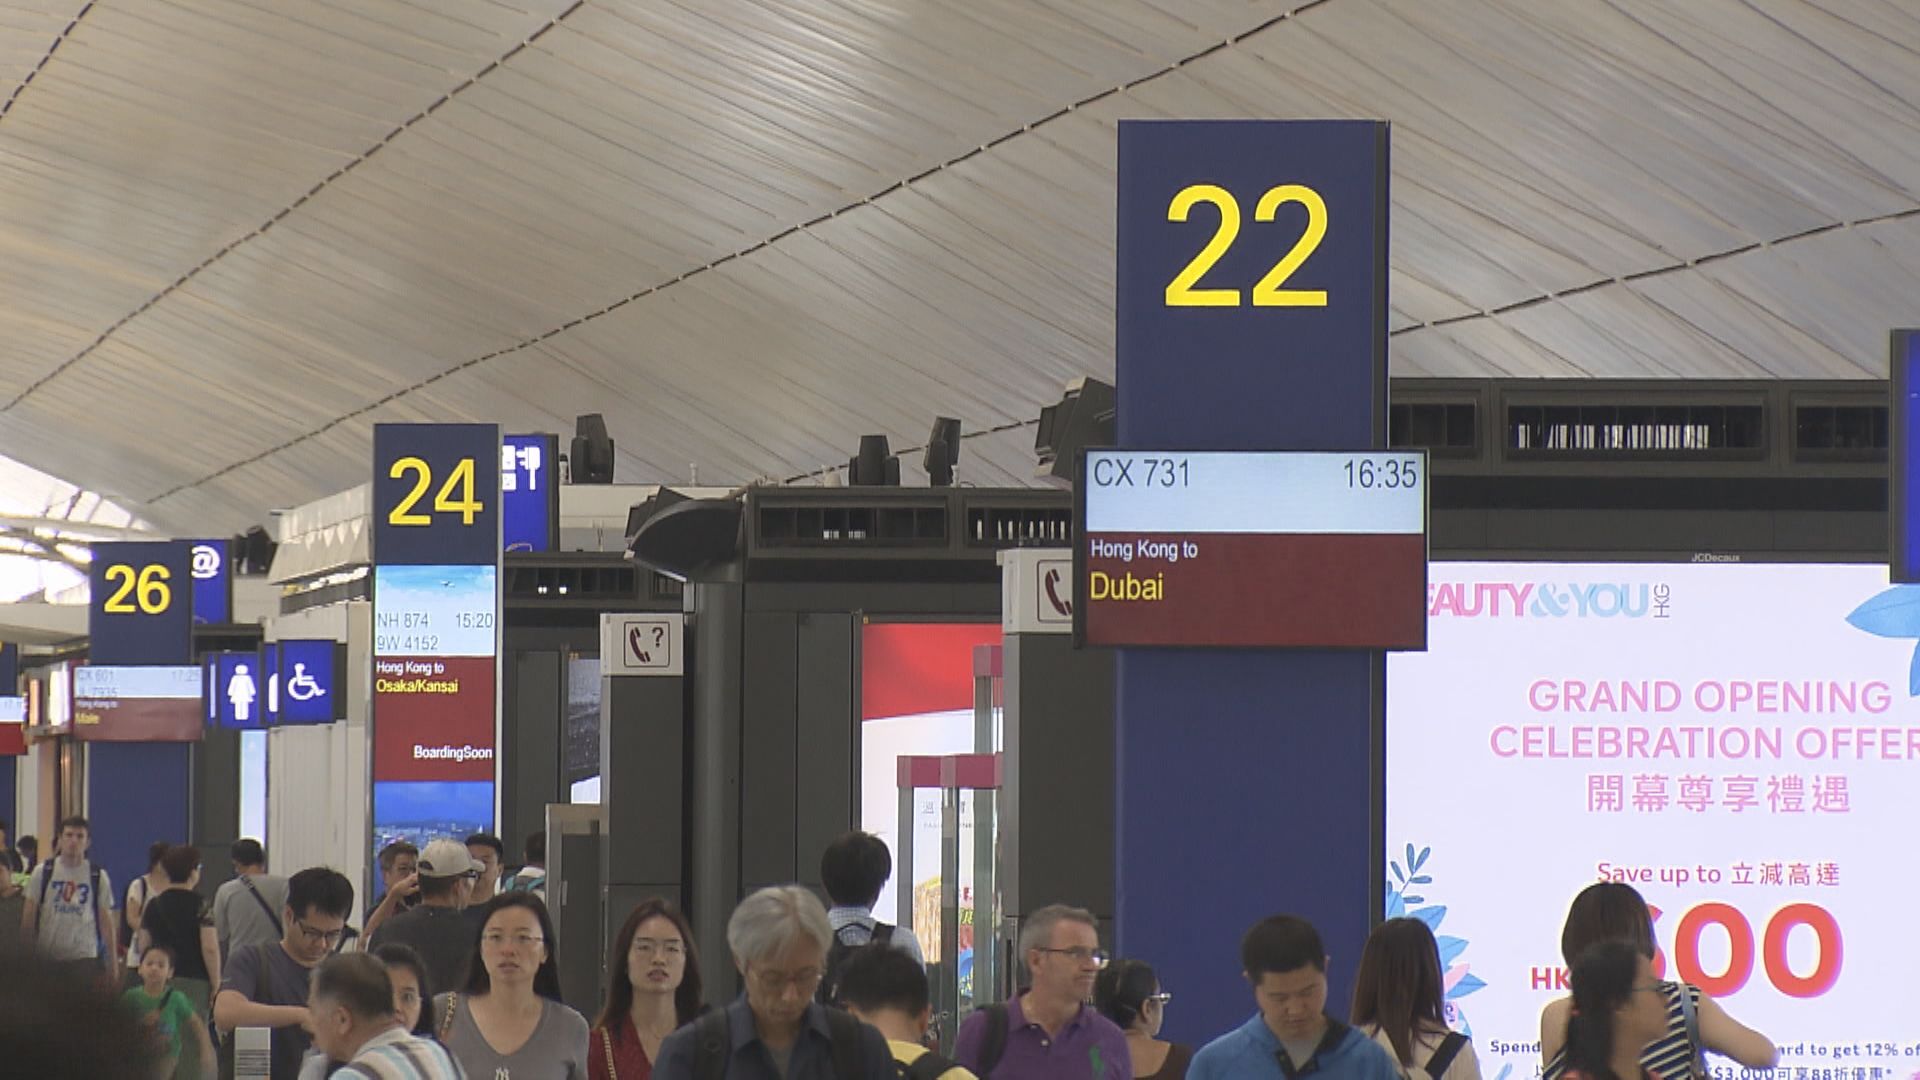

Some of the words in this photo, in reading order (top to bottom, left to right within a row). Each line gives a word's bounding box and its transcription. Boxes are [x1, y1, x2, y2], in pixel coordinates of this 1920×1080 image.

[1165, 184, 1328, 306] 22
[1094, 459, 1134, 487] CX
[1144, 459, 1189, 487] 731
[1344, 459, 1417, 488] 16:35
[389, 457, 483, 525] 24
[1091, 539, 1133, 562] Hong
[1138, 539, 1178, 562] Kong
[1183, 541, 1198, 558] to
[1691, 553, 1740, 562] JCDecaux
[104, 564, 171, 614] 26
[1090, 571, 1163, 600] Dubai
[1654, 583, 1670, 618] HKG
[377, 613, 399, 628] NH
[404, 613, 429, 628] 874
[456, 613, 493, 628] 15:20
[377, 635, 400, 650] 9W
[404, 635, 438, 650] 4152
[376, 661, 403, 676] Hong
[406, 661, 432, 676] Kong
[434, 661, 445, 674] to
[376, 679, 459, 692] Osaka/Kansai
[1529, 680, 1682, 713] GRAND
[1694, 681, 1891, 714] OPENING
[1490, 726, 1782, 759] CELEBRATION
[1588, 774, 1851, 813] 開幕尊享禮遇
[1598, 863, 1652, 883] Save
[1660, 867, 1689, 888] up
[1696, 865, 1721, 883] to
[1731, 862, 1840, 887] 立減高達
[1490, 1040, 1541, 1056] Spend
[1811, 1043, 1827, 1056] to
[1833, 1044, 1859, 1059] get
[1866, 1042, 1898, 1056] 12%
